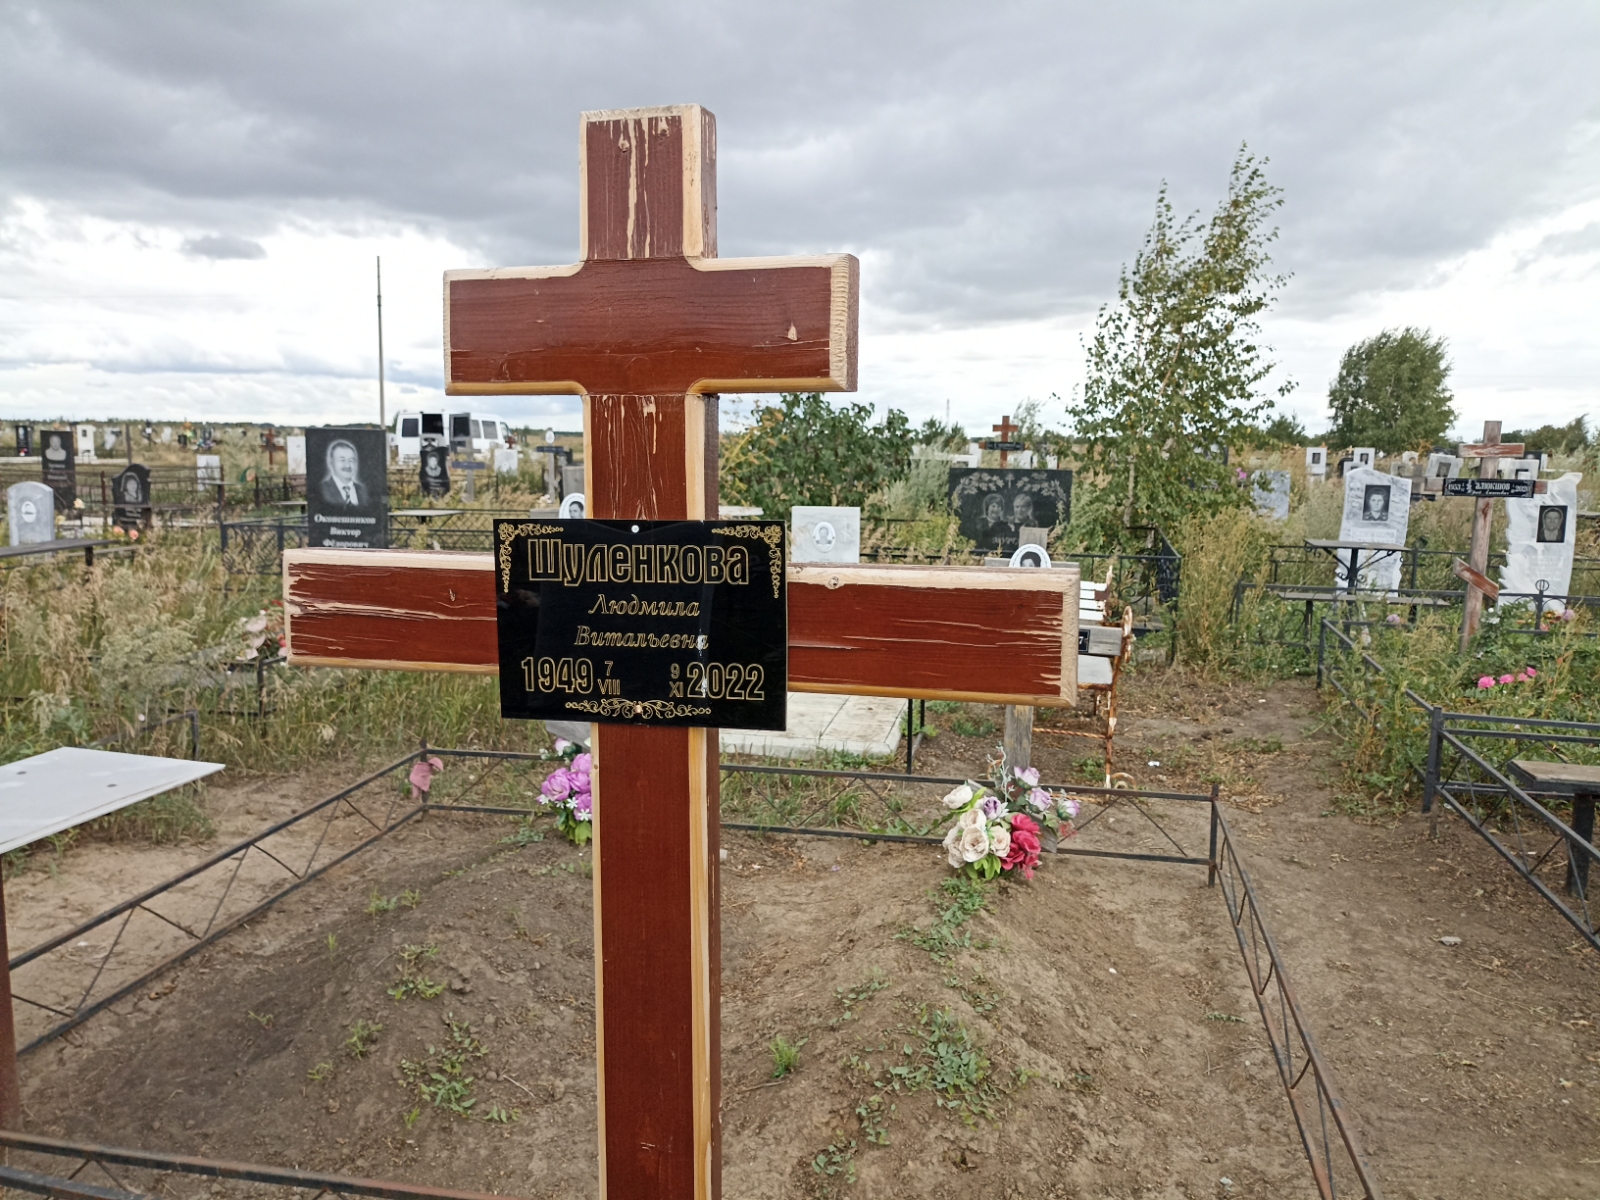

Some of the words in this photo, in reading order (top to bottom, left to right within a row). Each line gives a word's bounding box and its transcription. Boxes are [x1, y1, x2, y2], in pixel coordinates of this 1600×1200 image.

[330, 526, 362, 538] Виктор
[527, 538, 749, 587] Шуленкова
[588, 593, 700, 618] Людмила
[573, 625, 709, 650] Витальевна
[521, 656, 594, 694] 1949
[604, 660, 614, 676] 7
[670, 663, 680, 680] 9
[597, 679, 621, 696] VIII
[669, 680, 684, 698] XI
[686, 661, 765, 701] 2022
